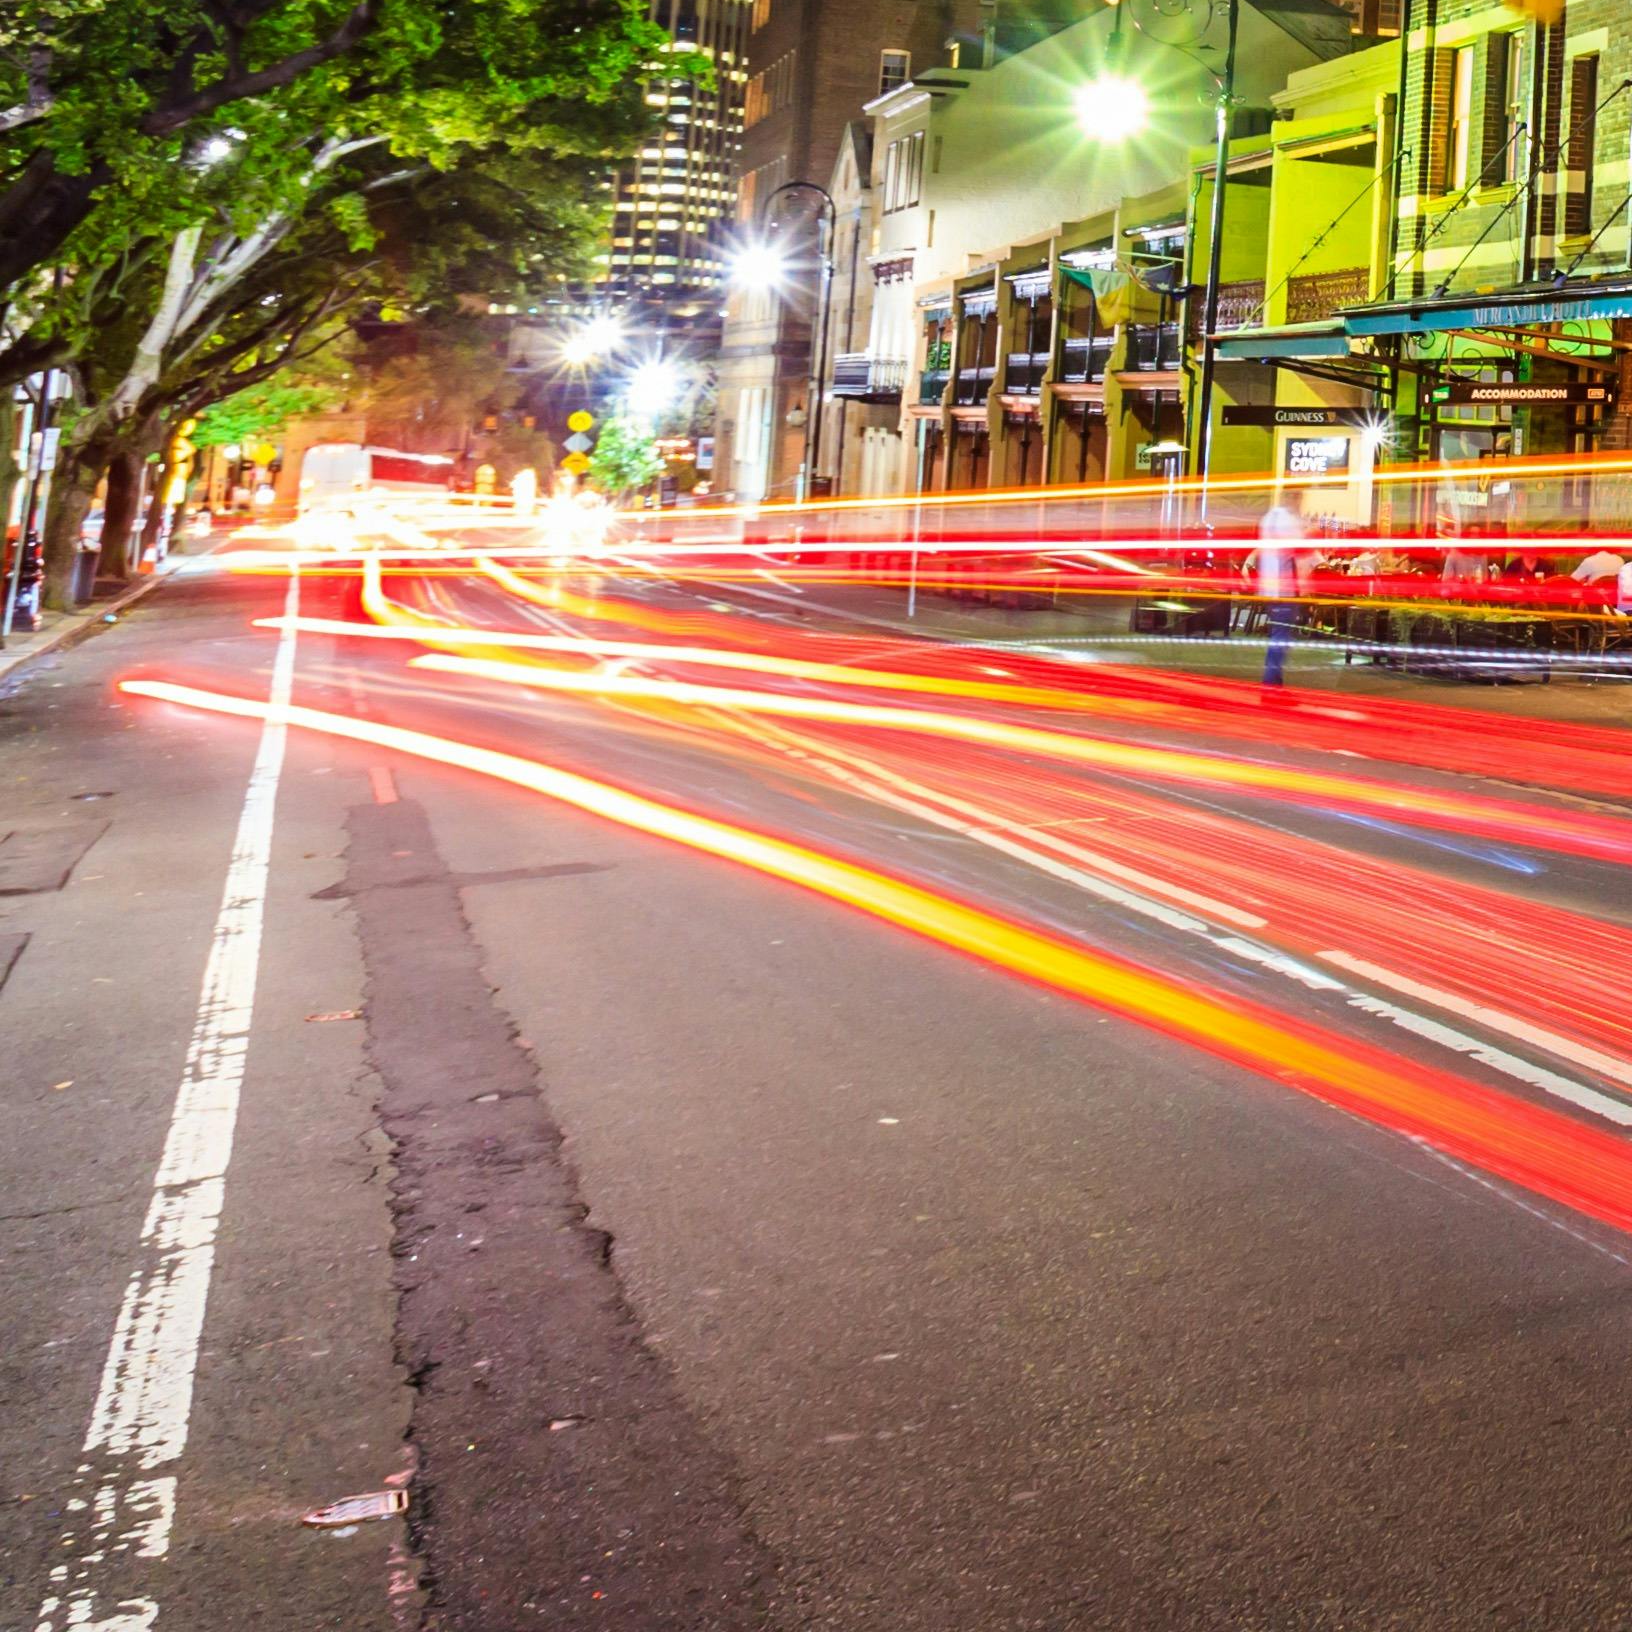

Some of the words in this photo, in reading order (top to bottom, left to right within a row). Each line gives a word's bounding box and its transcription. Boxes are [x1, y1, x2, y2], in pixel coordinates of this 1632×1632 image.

[1471, 388, 1568, 400] ACCOMMODATION
[1275, 410, 1324, 423] GUINNESS
[1290, 441, 1347, 457] SYDY
[1290, 456, 1328, 472] COVE
